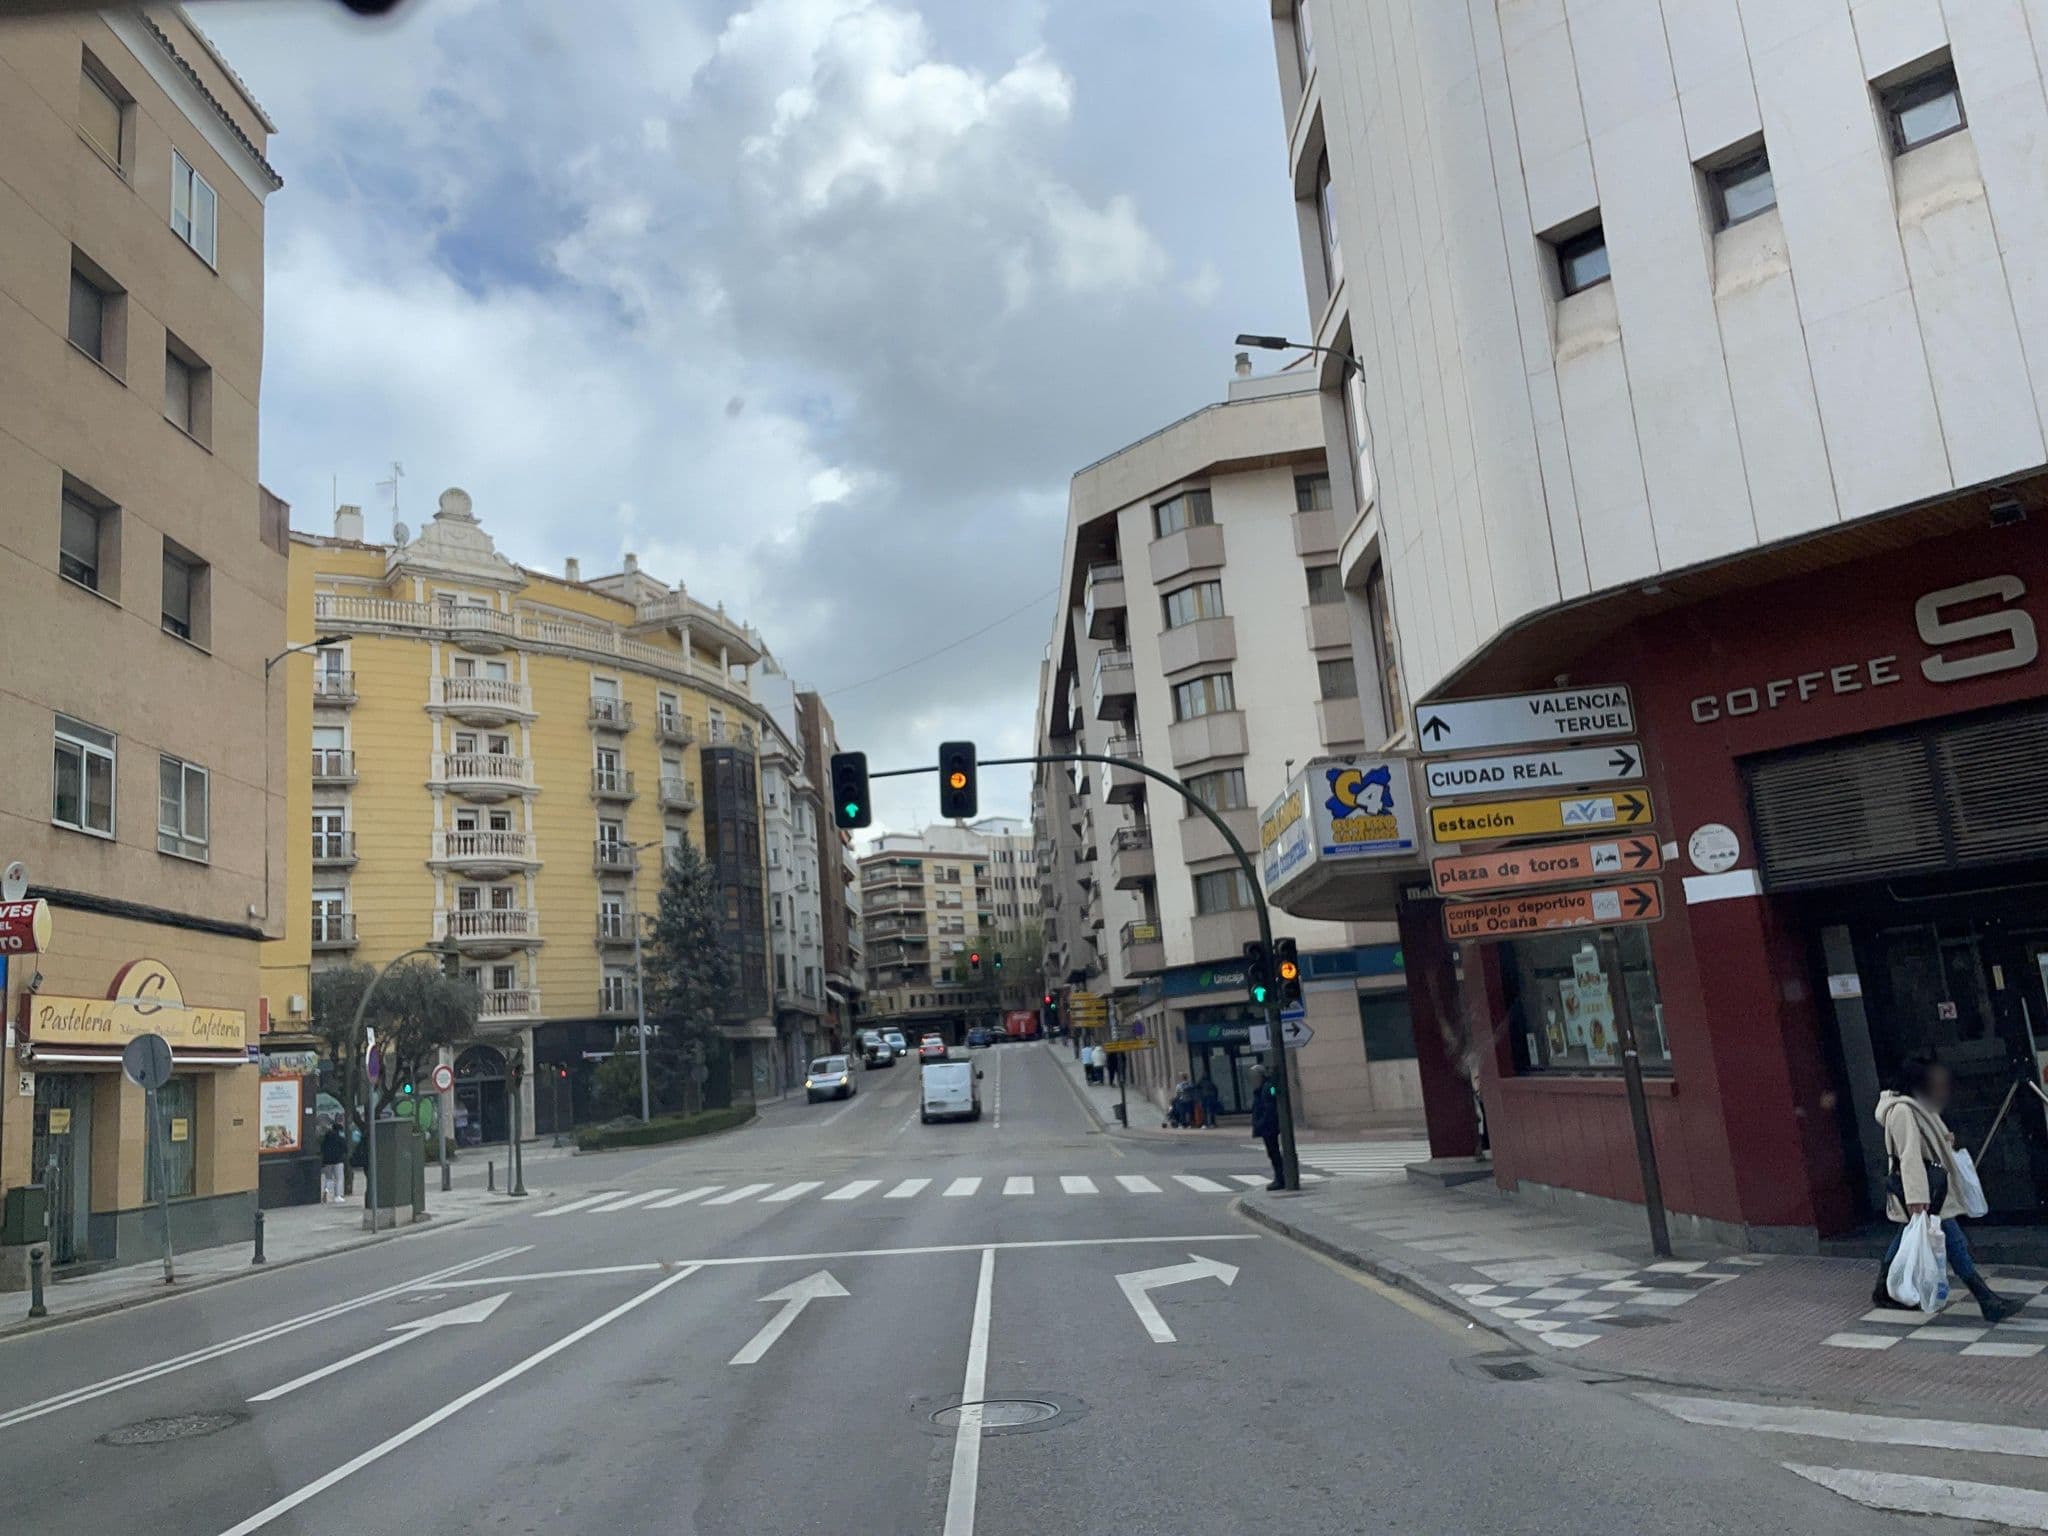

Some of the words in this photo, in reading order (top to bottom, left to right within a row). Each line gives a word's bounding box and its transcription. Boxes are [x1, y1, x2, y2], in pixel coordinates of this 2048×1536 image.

[1690, 655, 1900, 723] COFFEE
[1914, 574, 2039, 682] S
[1529, 692, 1627, 716] VALENCIA
[1555, 713, 1629, 735] TERUEL
[1431, 766, 1505, 788] CIUDAD
[1513, 761, 1563, 780] REAL
[1437, 811, 1515, 833] estación
[1438, 864, 1489, 886] plaza
[1497, 857, 1520, 876] de
[1528, 853, 1580, 872] toros
[1448, 902, 1511, 921] complejo
[1517, 895, 1586, 917] deportivo
[1448, 919, 1480, 936] Luis
[1487, 914, 1538, 931] Ocaña
[1222, 1028, 1249, 1037] Unicaj
